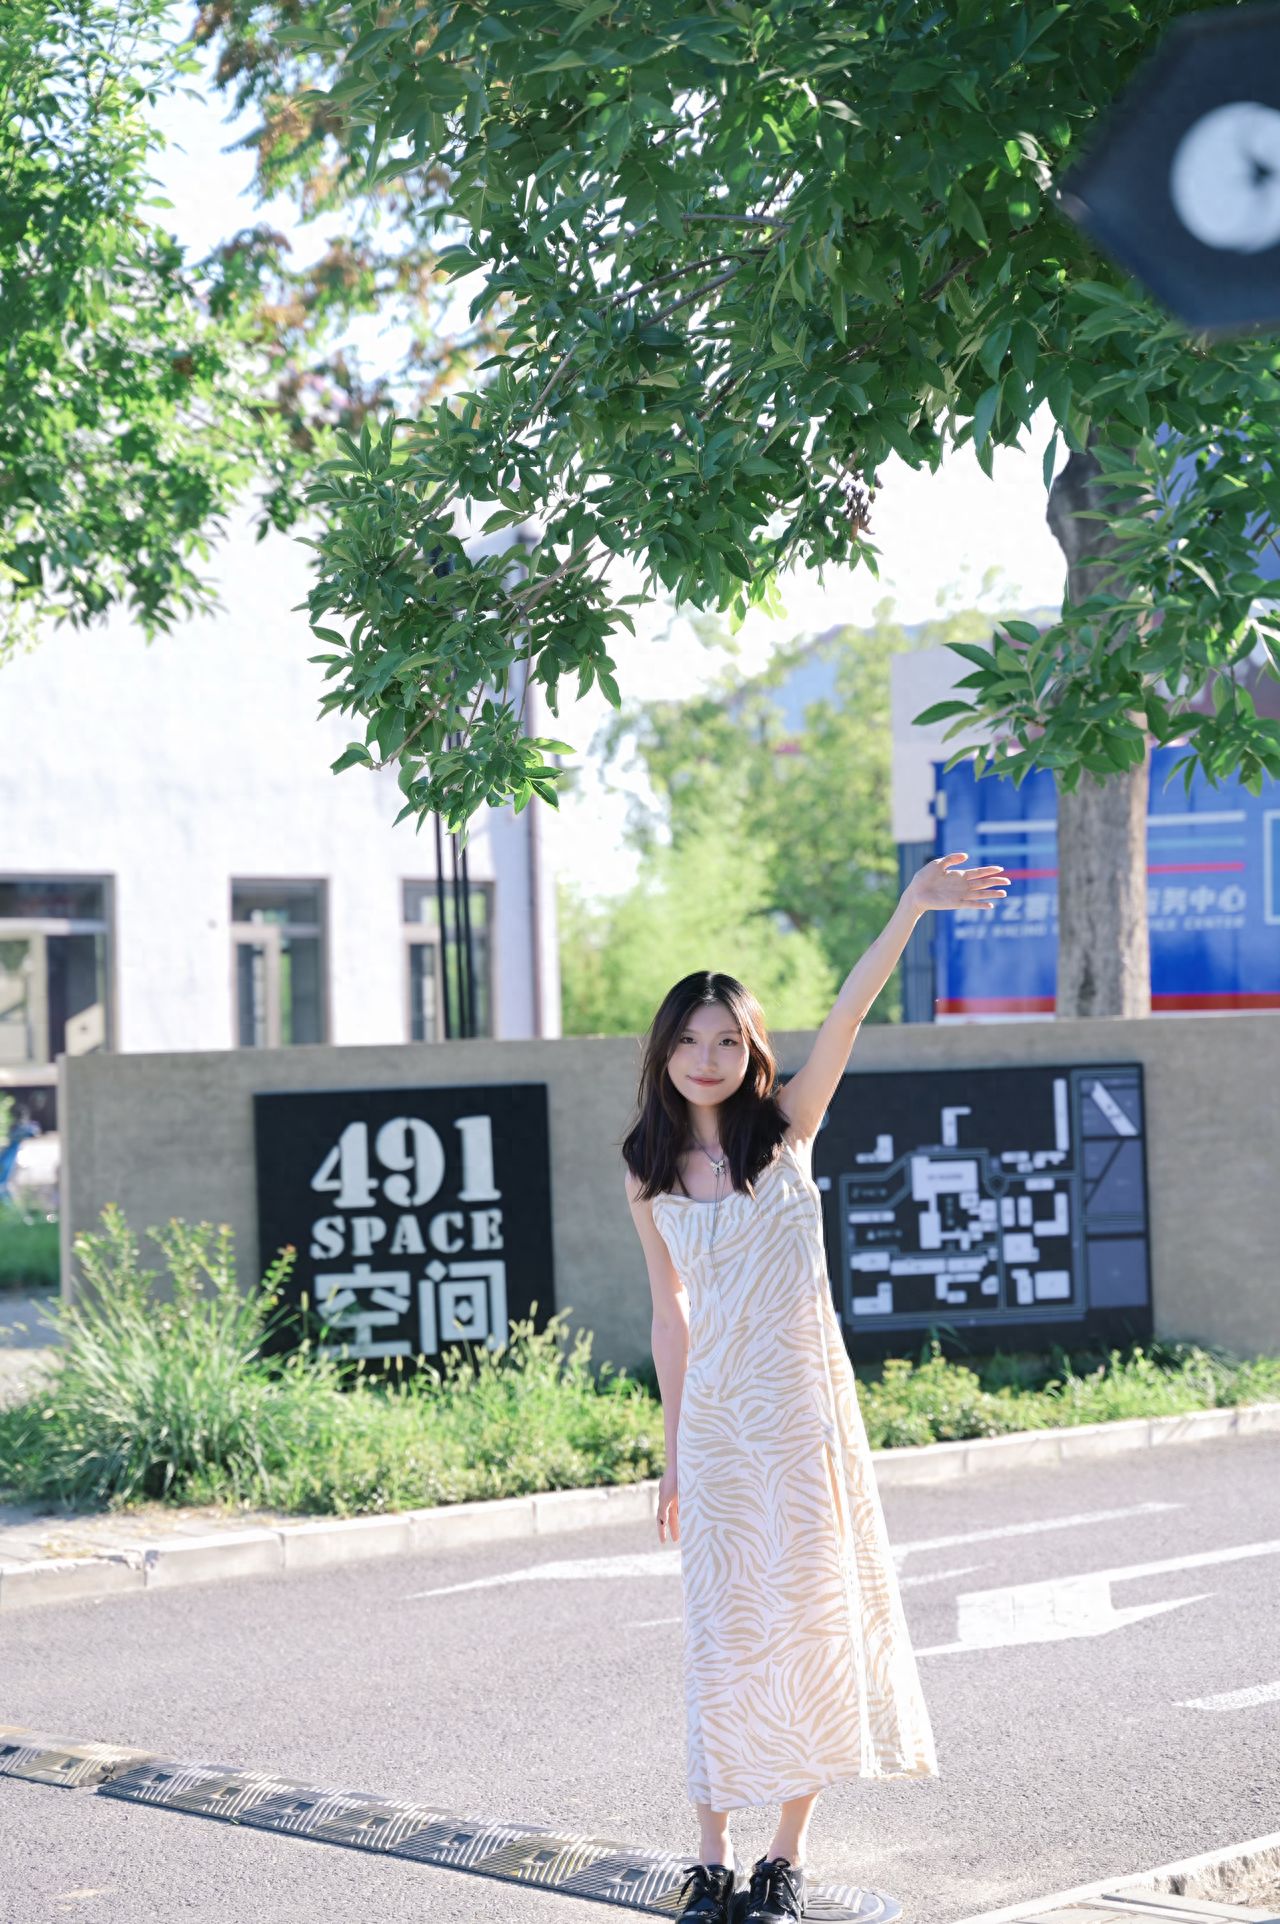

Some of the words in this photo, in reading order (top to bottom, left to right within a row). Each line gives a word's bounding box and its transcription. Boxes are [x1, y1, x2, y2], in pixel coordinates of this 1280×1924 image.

[311, 1115, 502, 1209] 491
[309, 1208, 504, 1260] SPACE
[314, 1259, 508, 1358] 空间
